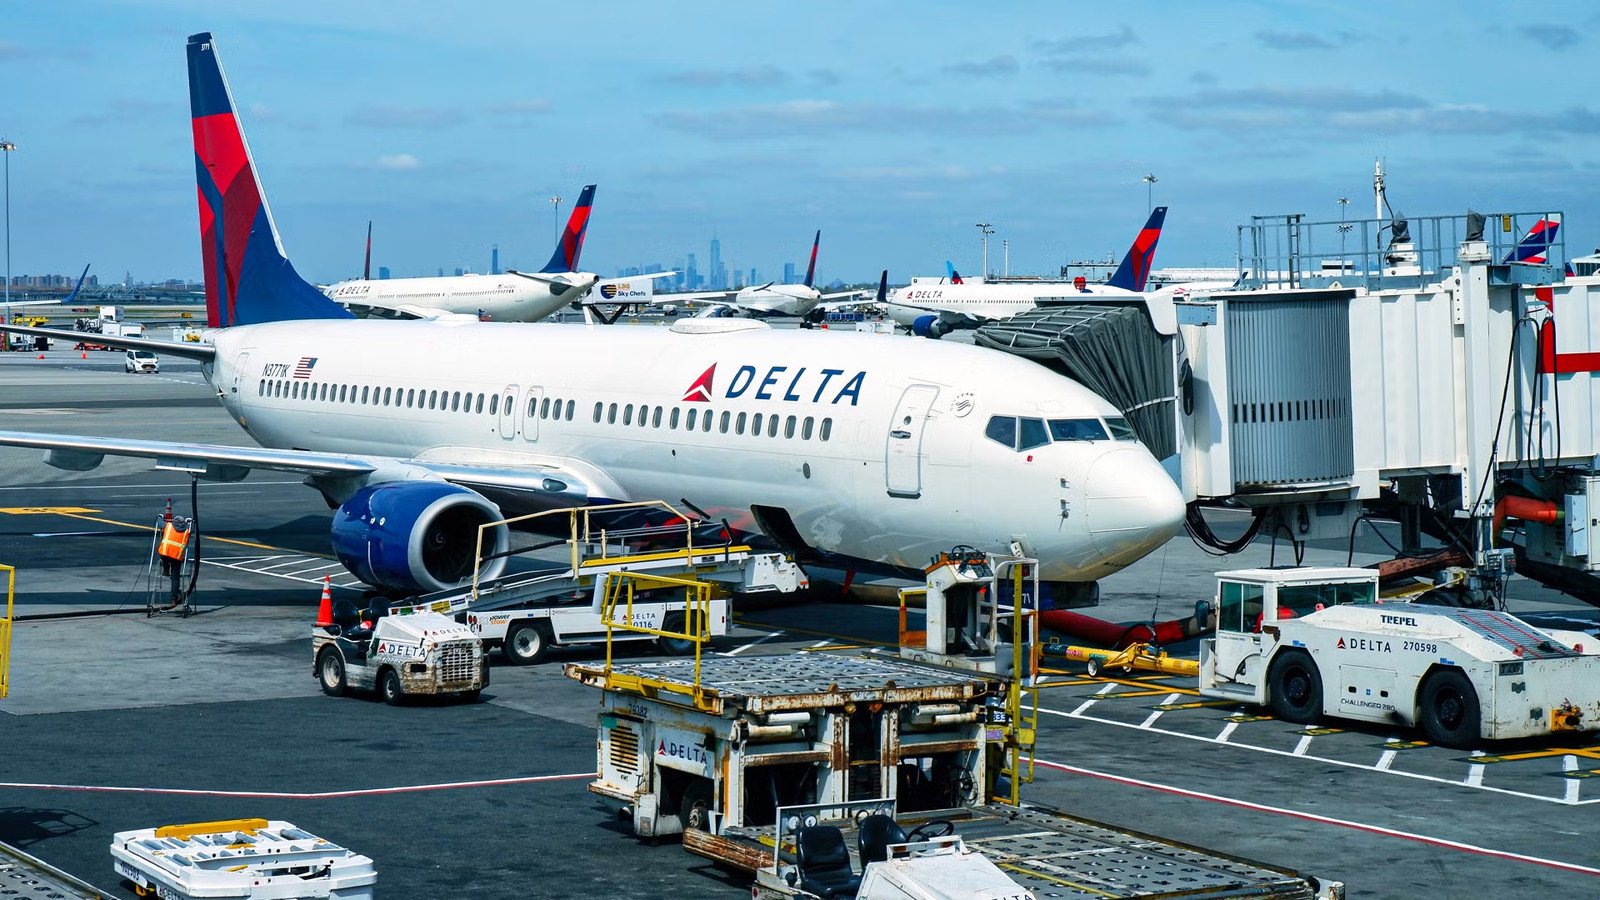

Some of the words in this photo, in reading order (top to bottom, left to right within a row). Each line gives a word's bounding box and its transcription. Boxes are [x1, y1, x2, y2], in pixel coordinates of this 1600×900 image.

[345, 286, 370, 295] DELTA
[915, 290, 943, 298] DELTA
[262, 363, 291, 378] N3771K
[725, 365, 867, 406] DELTA
[631, 612, 656, 620] DELTA
[1380, 614, 1418, 627] TREPEL
[440, 627, 468, 635] DELTA
[388, 645, 426, 658] DELTA
[1350, 638, 1391, 653] DELTA
[1403, 641, 1437, 654] 270598
[628, 703, 648, 718] 79382
[1340, 698, 1381, 709] CHALLENGER
[1382, 703, 1396, 712] 280
[670, 742, 707, 765] DELTA
